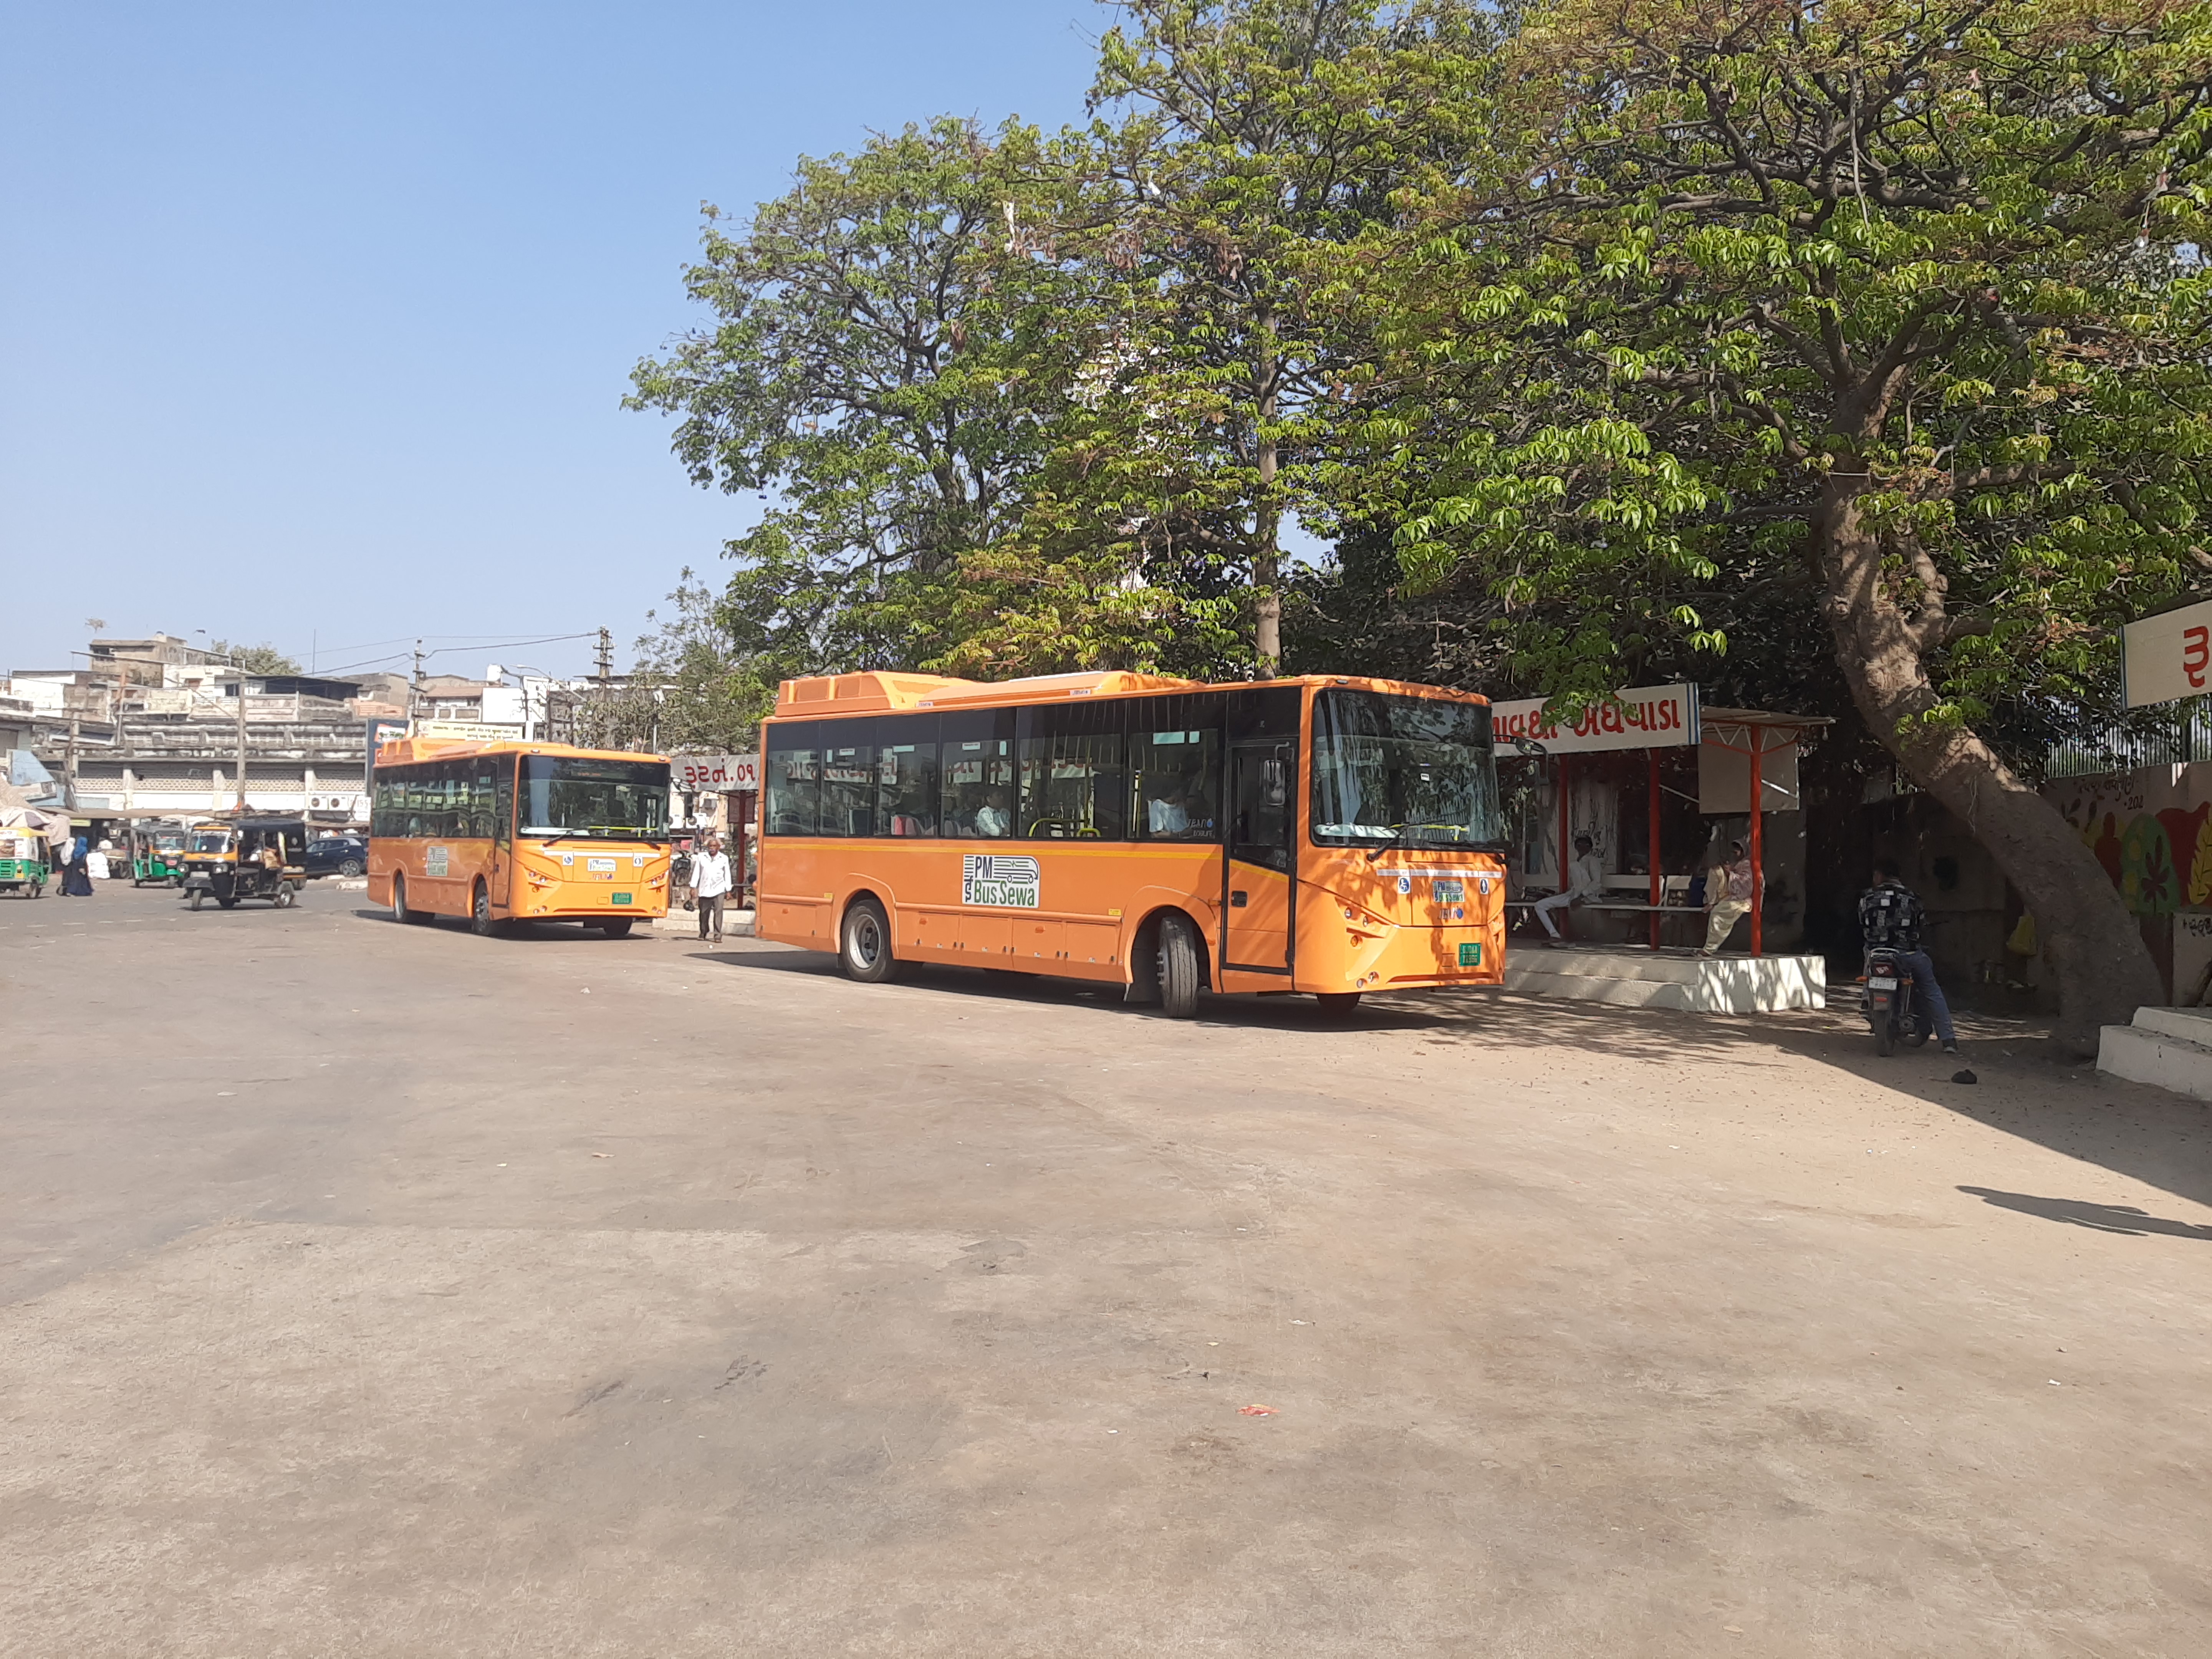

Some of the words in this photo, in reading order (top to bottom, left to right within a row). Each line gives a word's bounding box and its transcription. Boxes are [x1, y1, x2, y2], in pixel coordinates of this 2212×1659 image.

[975, 856, 993, 879] PM
[974, 880, 997, 904] Bus
[999, 881, 1035, 906] Sewa
